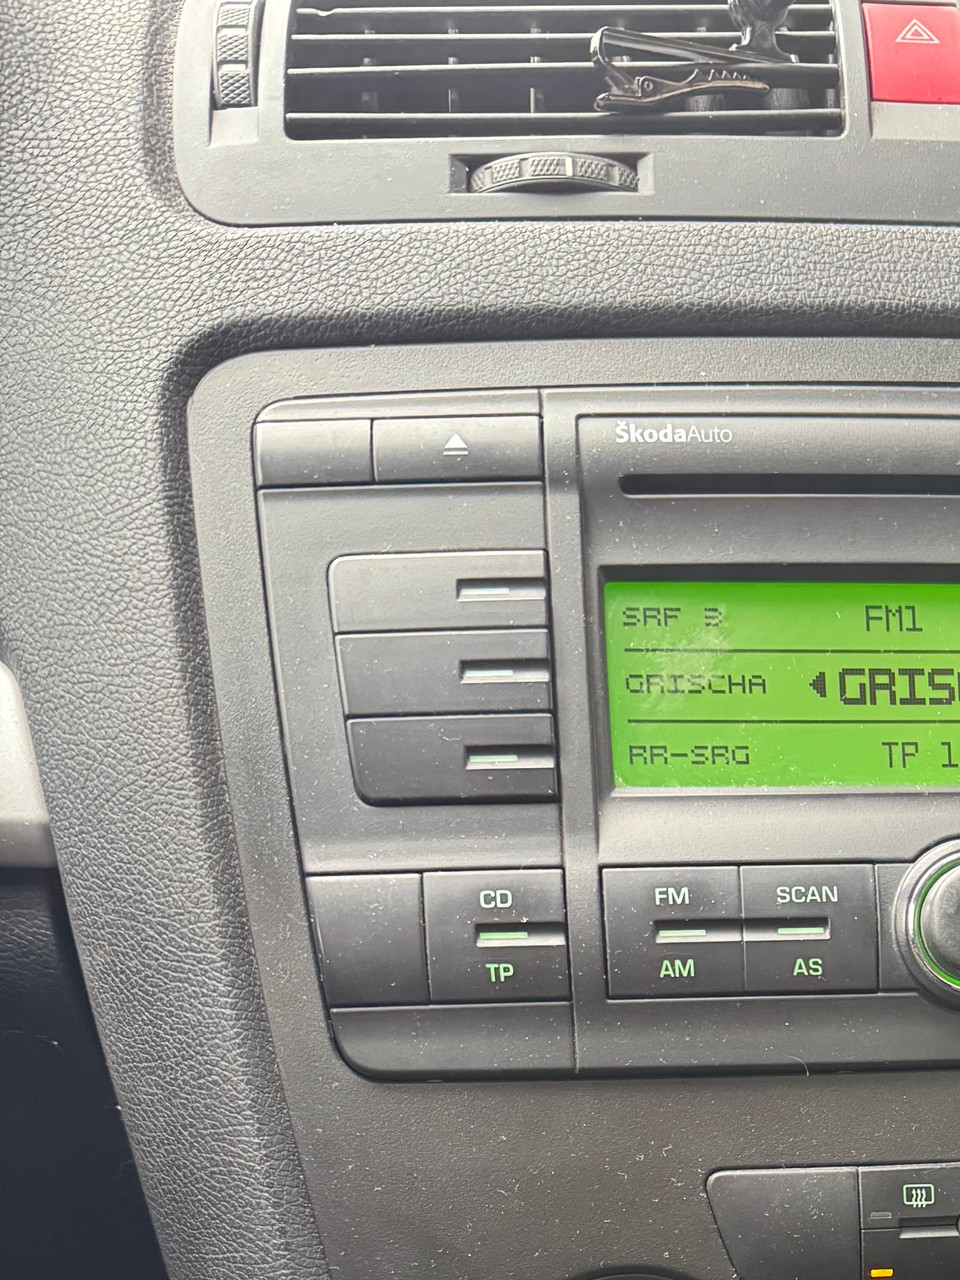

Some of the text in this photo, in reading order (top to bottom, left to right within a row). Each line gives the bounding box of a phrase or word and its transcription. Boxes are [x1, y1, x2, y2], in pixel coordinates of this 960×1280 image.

[622, 607, 724, 627] SRF 3
[864, 605, 923, 632] FM1
[625, 674, 767, 695] GRISCHA
[629, 745, 750, 766] RR-SRG
[881, 741, 919, 769] TP
[479, 889, 513, 909] CD
[654, 887, 690, 906] FM
[776, 885, 839, 904] SCAN
[485, 963, 514, 983] TP
[659, 959, 696, 978] AM
[793, 957, 823, 976] AS
